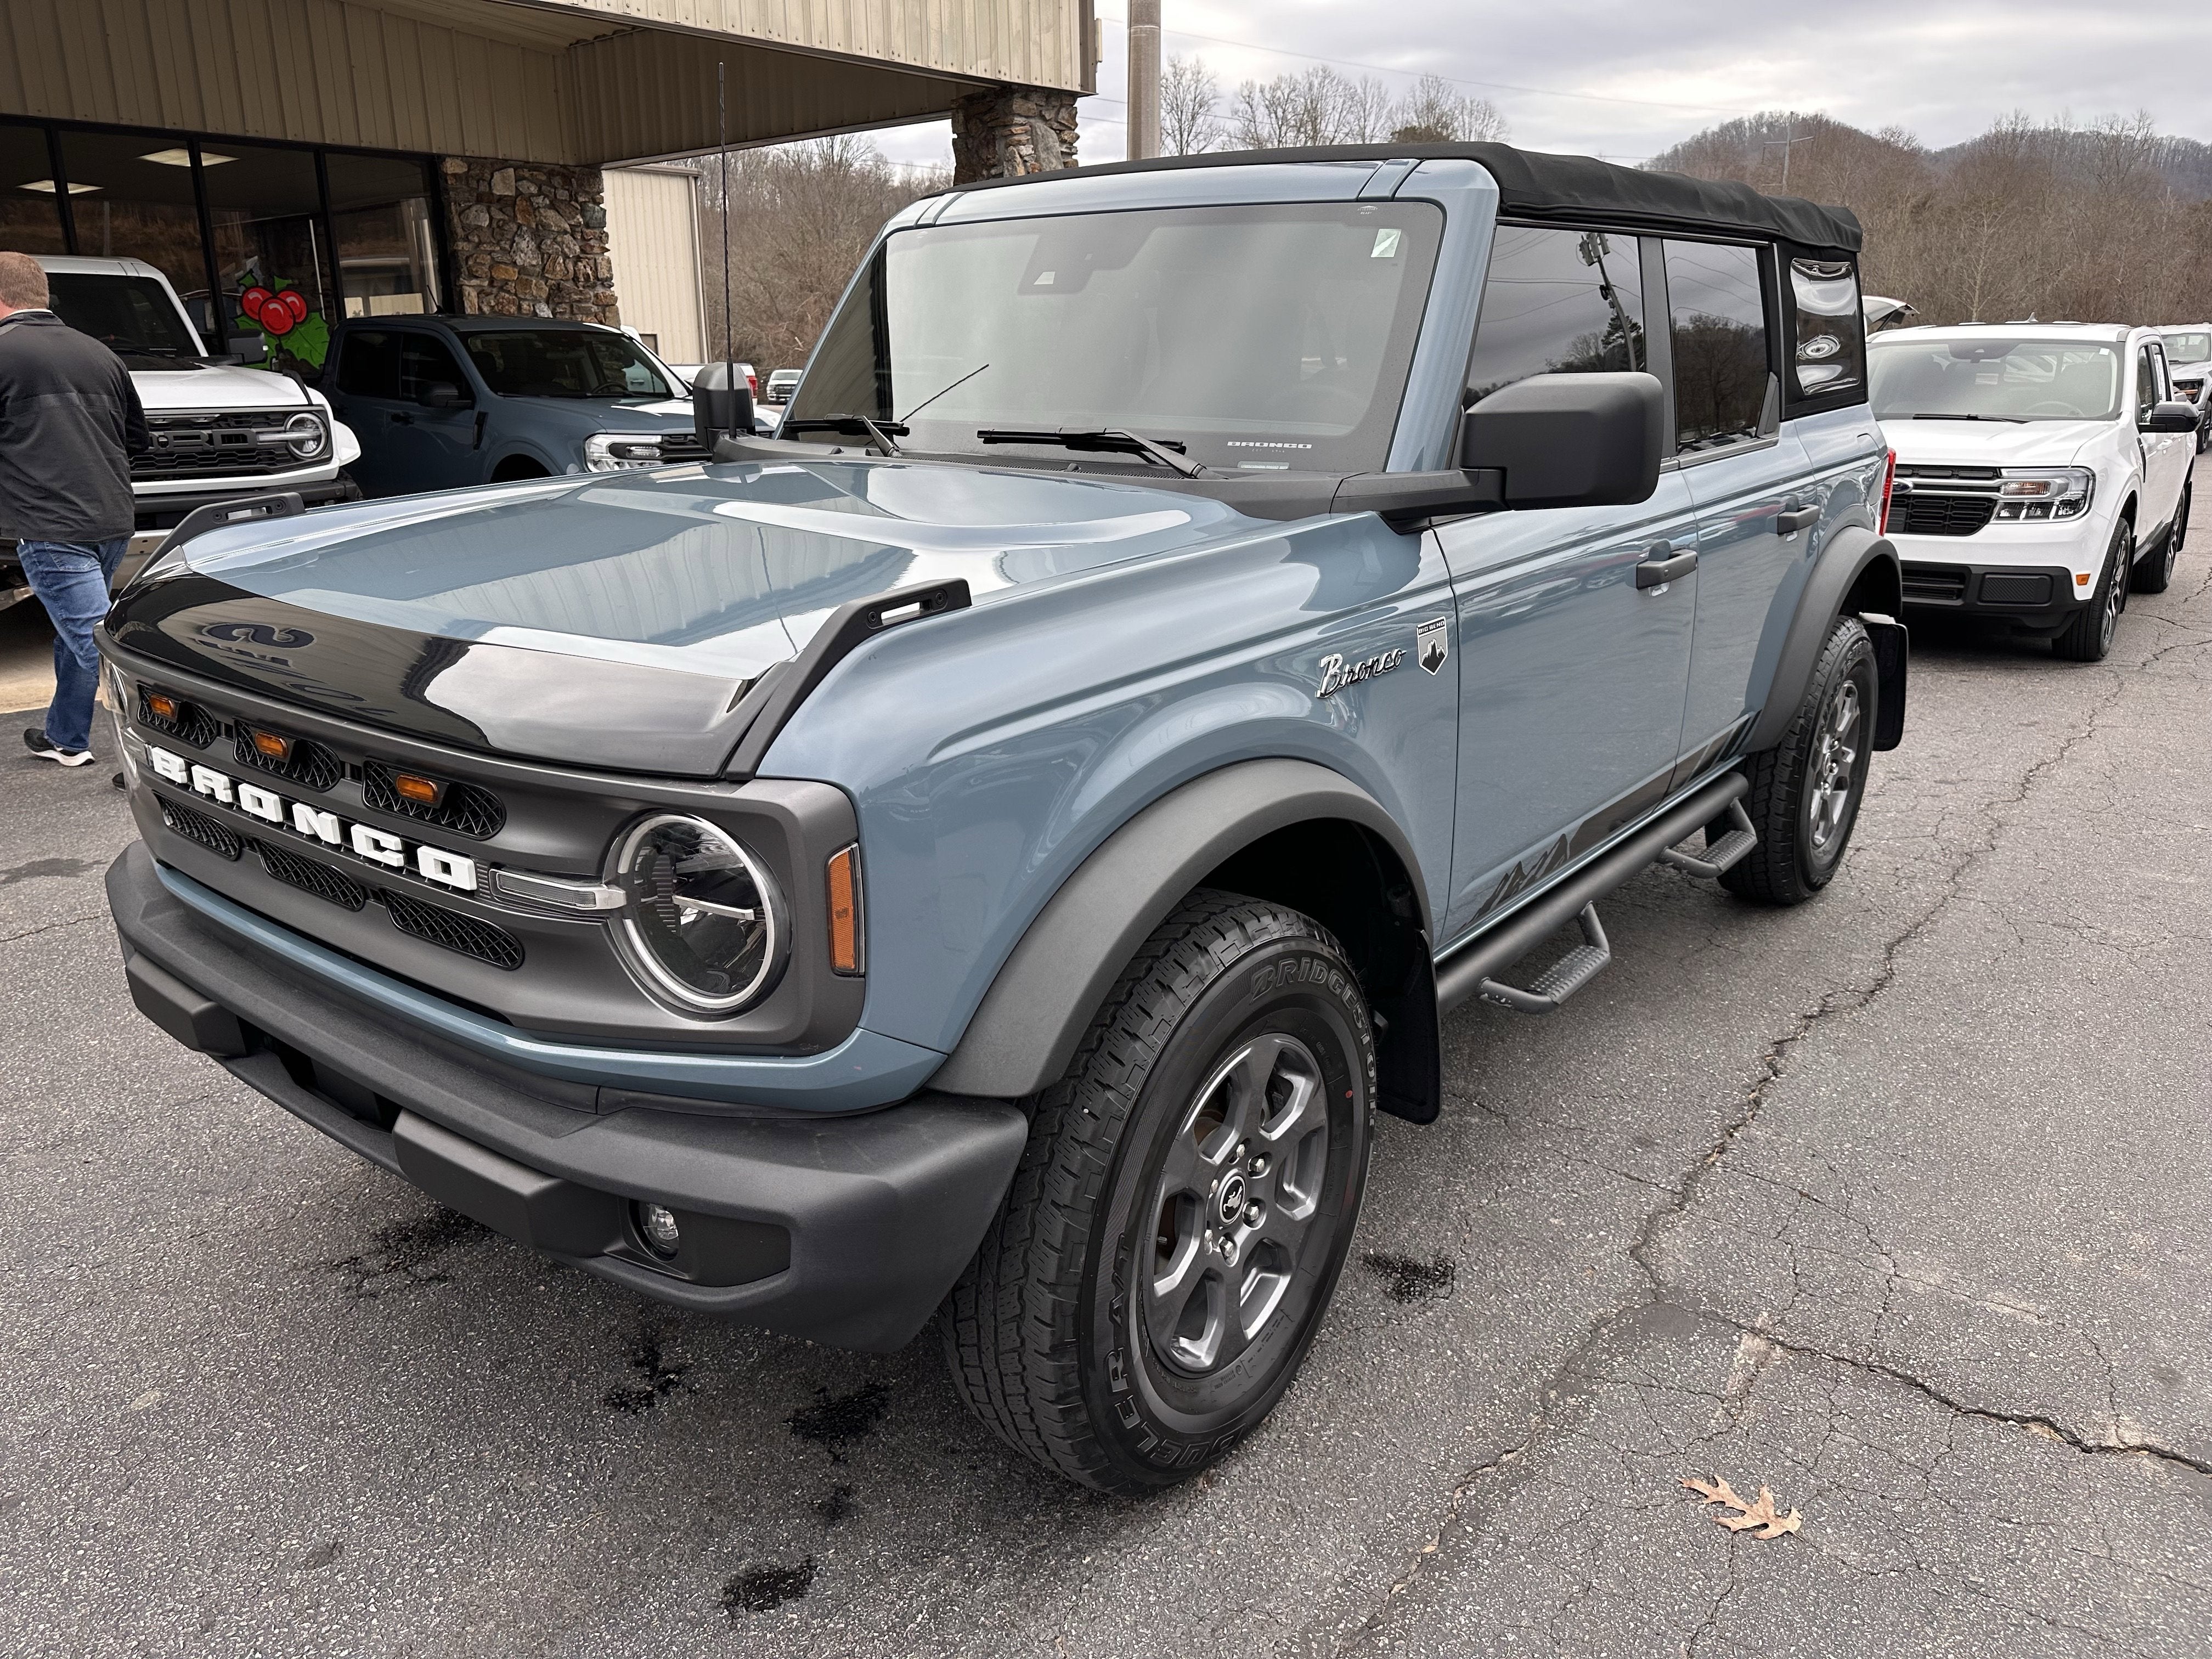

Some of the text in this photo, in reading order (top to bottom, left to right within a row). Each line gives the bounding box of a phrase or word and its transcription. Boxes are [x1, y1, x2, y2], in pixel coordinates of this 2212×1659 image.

[1429, 620, 1444, 630] BEND
[1315, 648, 1407, 698] Bronco
[151, 747, 478, 891] BRONCO
